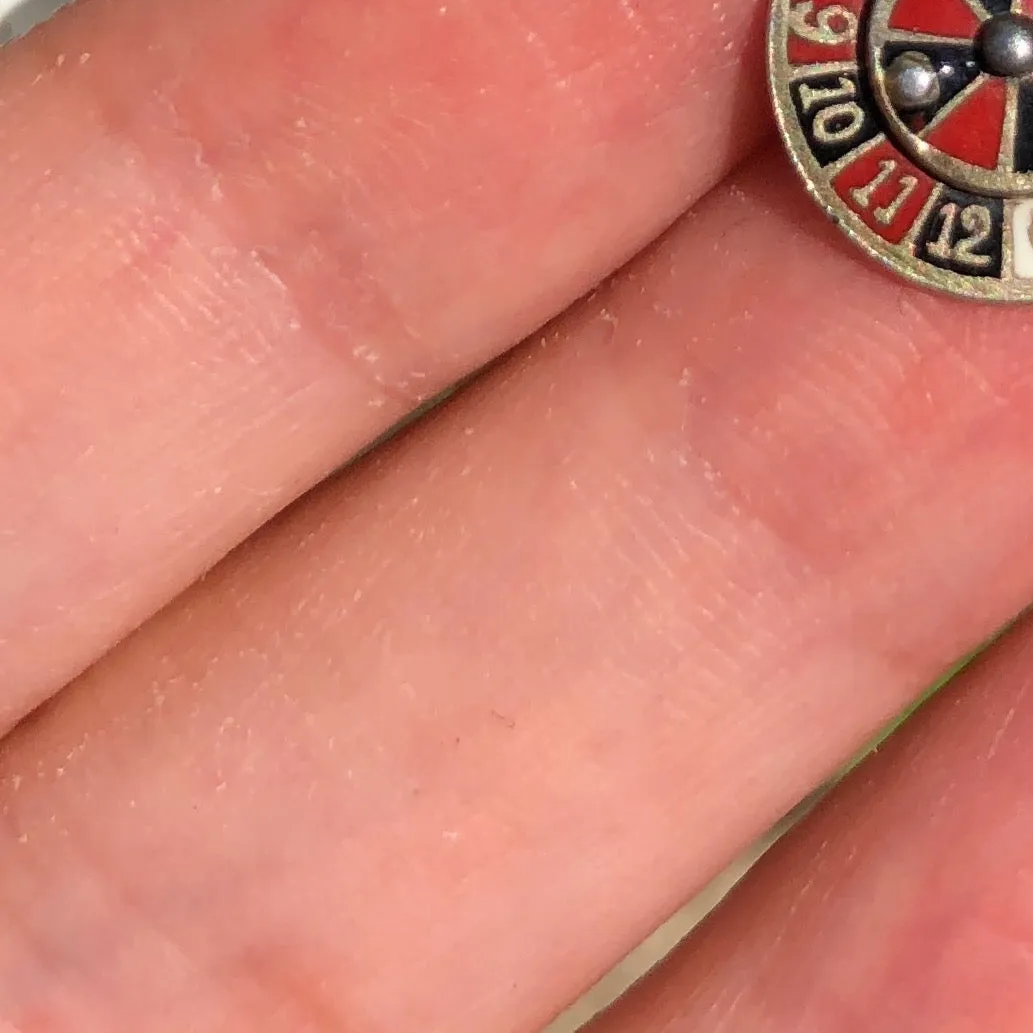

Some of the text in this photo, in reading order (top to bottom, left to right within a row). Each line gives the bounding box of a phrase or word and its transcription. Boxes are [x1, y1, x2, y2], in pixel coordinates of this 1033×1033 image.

[790, 0, 858, 45] 9
[799, 76, 865, 142] 10
[849, 159, 919, 225] 11
[925, 202, 993, 267] 12
